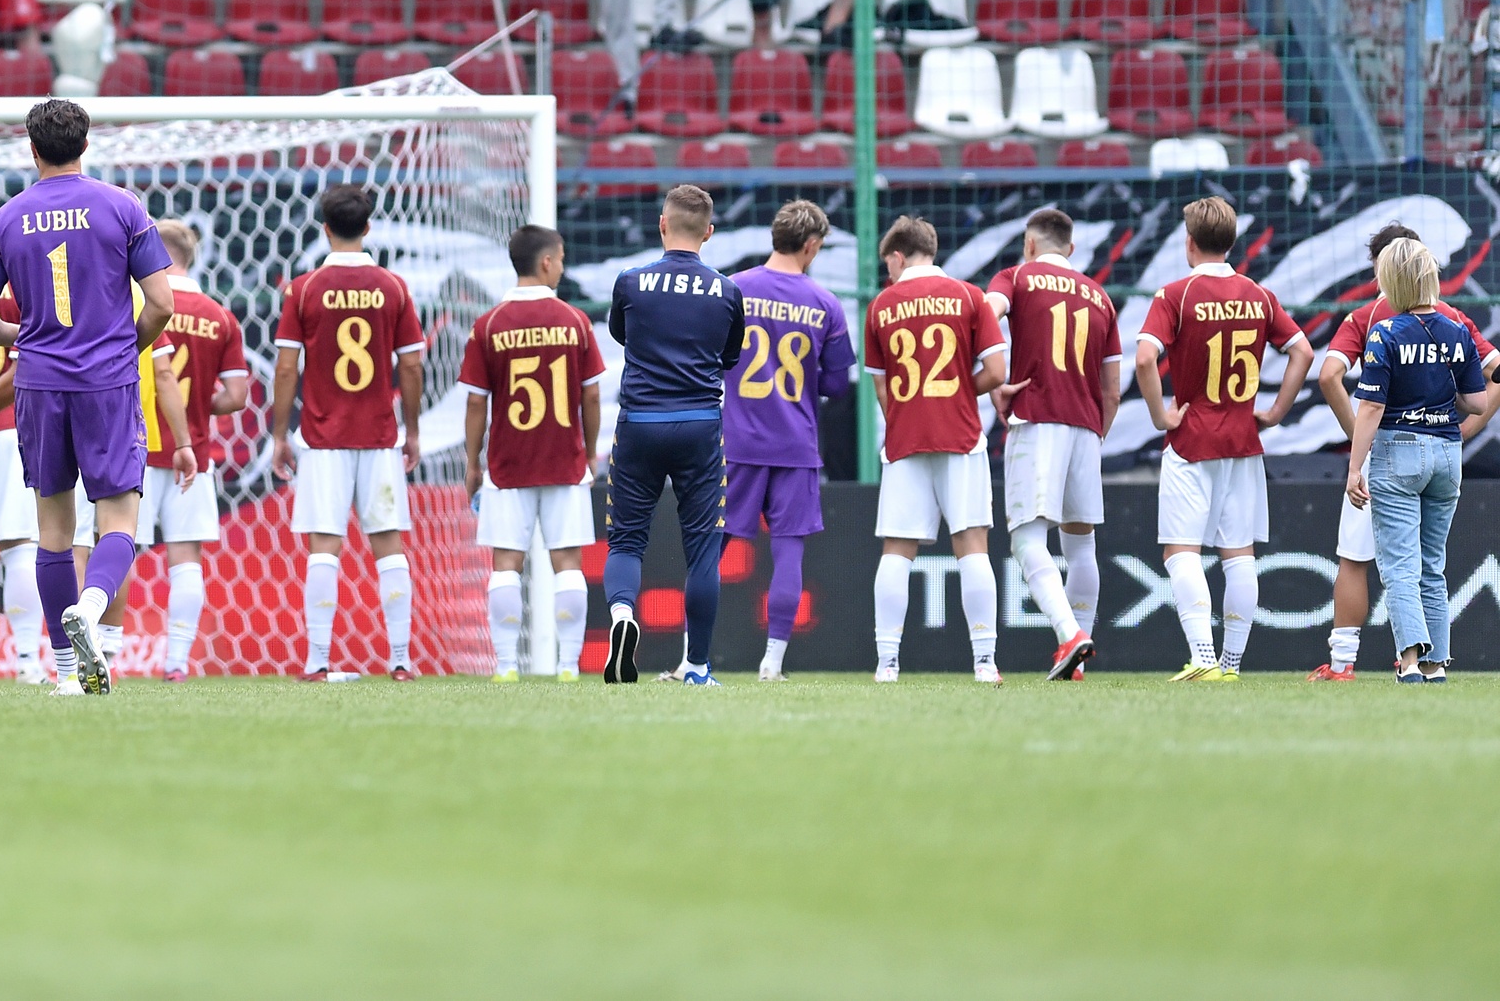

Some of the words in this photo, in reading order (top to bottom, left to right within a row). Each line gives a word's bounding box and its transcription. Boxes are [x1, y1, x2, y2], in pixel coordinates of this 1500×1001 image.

[22, 207, 90, 235] ŁUBIK
[46, 241, 73, 328] 1
[321, 288, 385, 310] CARBÓ
[638, 271, 723, 298] WISŁA
[1026, 273, 1077, 296] JORDI
[744, 297, 827, 330] ETKIEWICZ
[878, 295, 963, 329] PŁAWIŃSKI
[1194, 300, 1266, 322] STASZAK
[333, 315, 375, 393] 8
[492, 326, 580, 352] KUZIEMKA
[1049, 300, 1090, 377] 11
[1399, 342, 1466, 365] WISŁA
[739, 324, 812, 403] 28
[889, 323, 961, 403] 32
[1206, 328, 1260, 405] 15
[507, 353, 572, 432] 51
